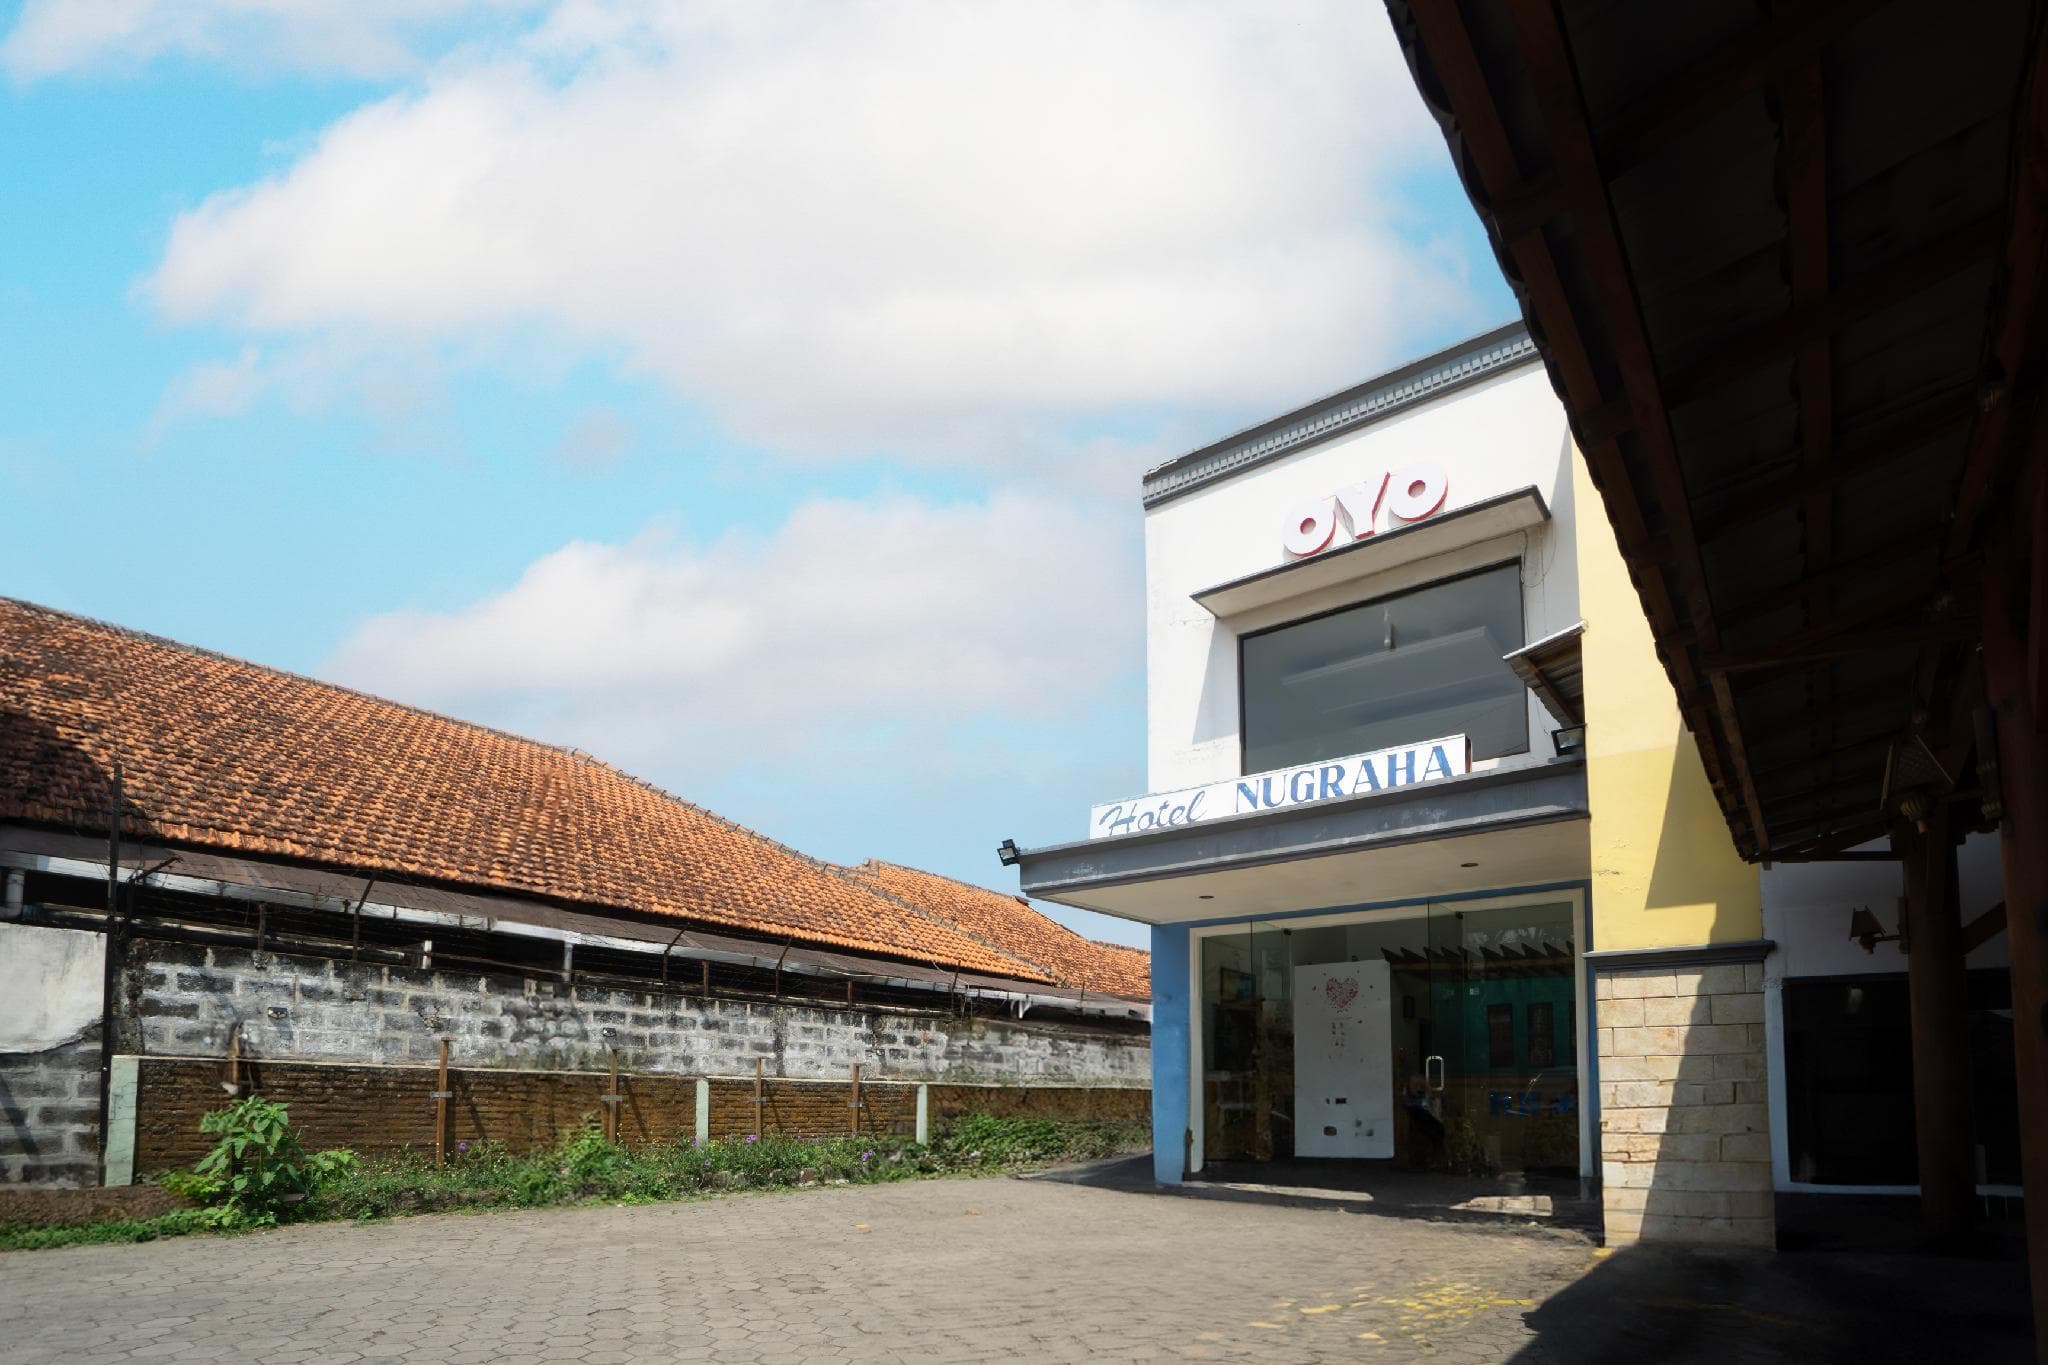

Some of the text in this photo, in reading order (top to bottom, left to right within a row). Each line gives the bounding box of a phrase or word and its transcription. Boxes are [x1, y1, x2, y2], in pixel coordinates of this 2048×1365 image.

[1283, 464, 1449, 559] OYO
[1099, 746, 1453, 836] Hotel NUGRAHA
